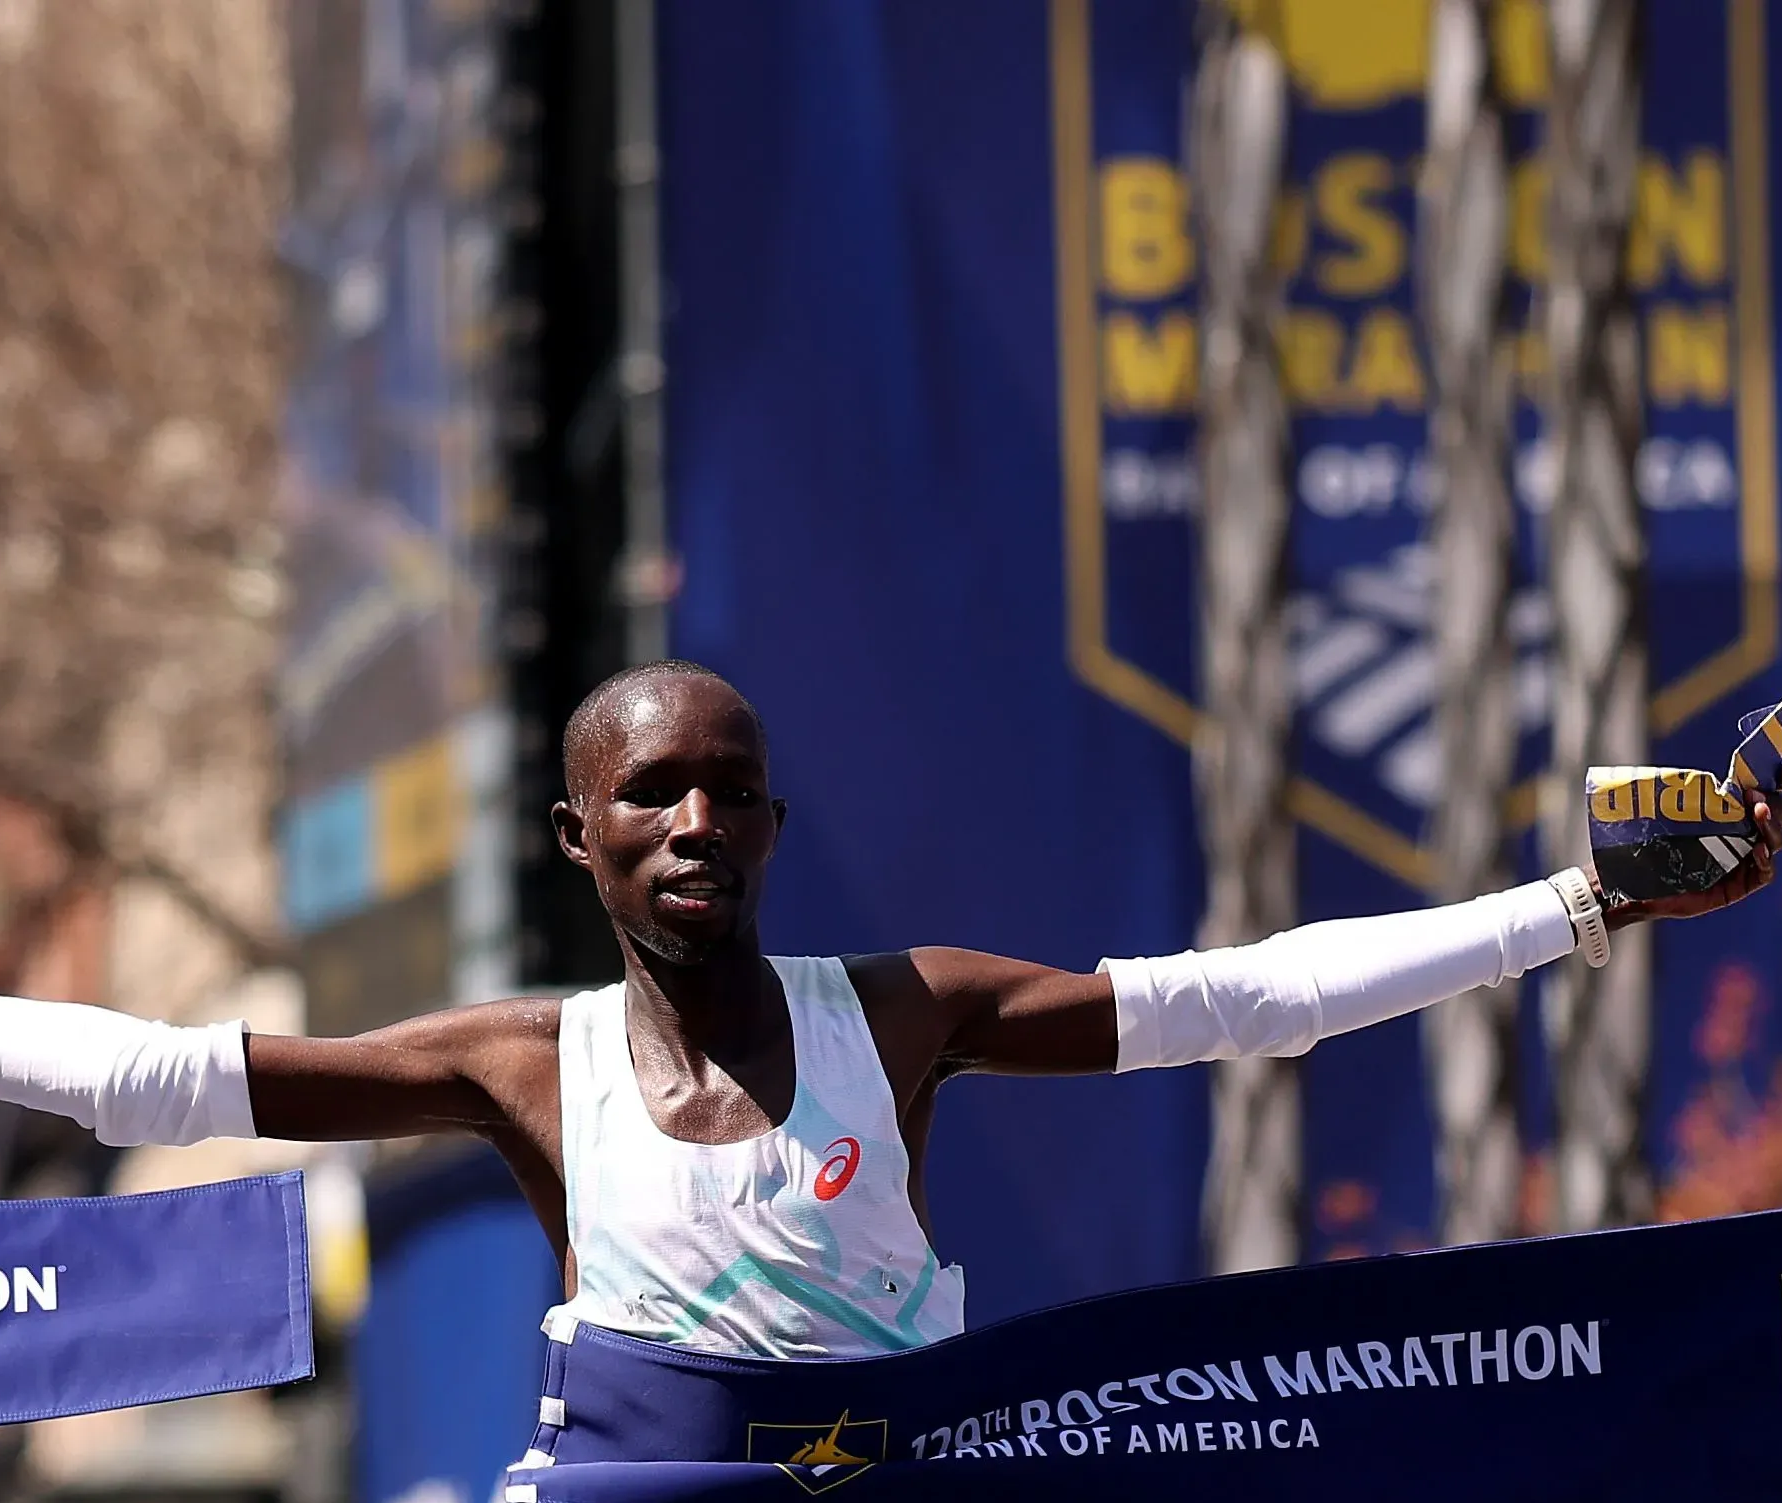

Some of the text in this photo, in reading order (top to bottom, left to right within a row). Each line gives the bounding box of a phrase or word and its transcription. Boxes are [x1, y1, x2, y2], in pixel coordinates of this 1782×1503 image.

[1262, 1320, 1602, 1399] MARATHON
[1059, 1424, 1116, 1457] OF
[1126, 1418, 1320, 1454] AMERICA
